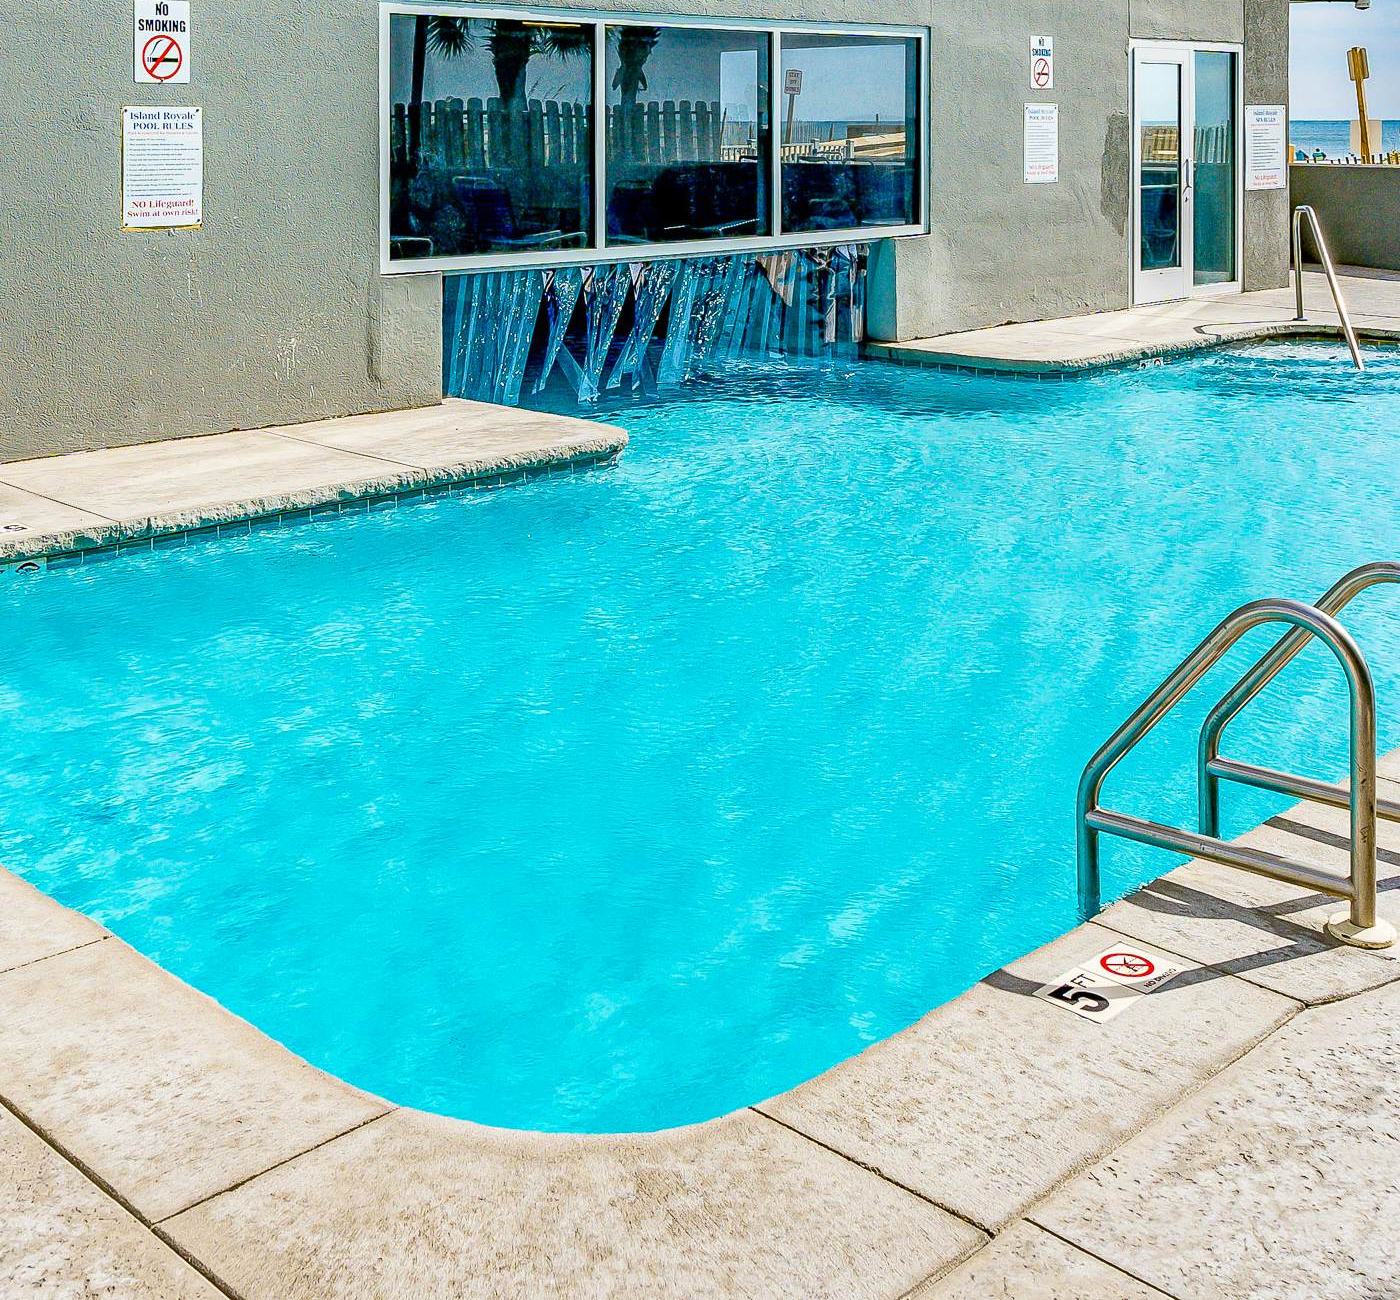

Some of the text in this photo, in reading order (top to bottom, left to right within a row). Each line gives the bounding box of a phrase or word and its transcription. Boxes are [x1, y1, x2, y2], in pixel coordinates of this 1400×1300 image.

[155, 3, 169, 16] NO
[138, 18, 186, 33] SMOKING
[1031, 48, 1051, 57] SMOKING
[130, 111, 196, 122] Island Royale
[133, 122, 194, 130] POOL RULES
[131, 199, 194, 209] NO Lifeguard!
[127, 210, 150, 218] Swim
[181, 208, 199, 216] risk!
[1047, 973, 1110, 1013] 5 FT
